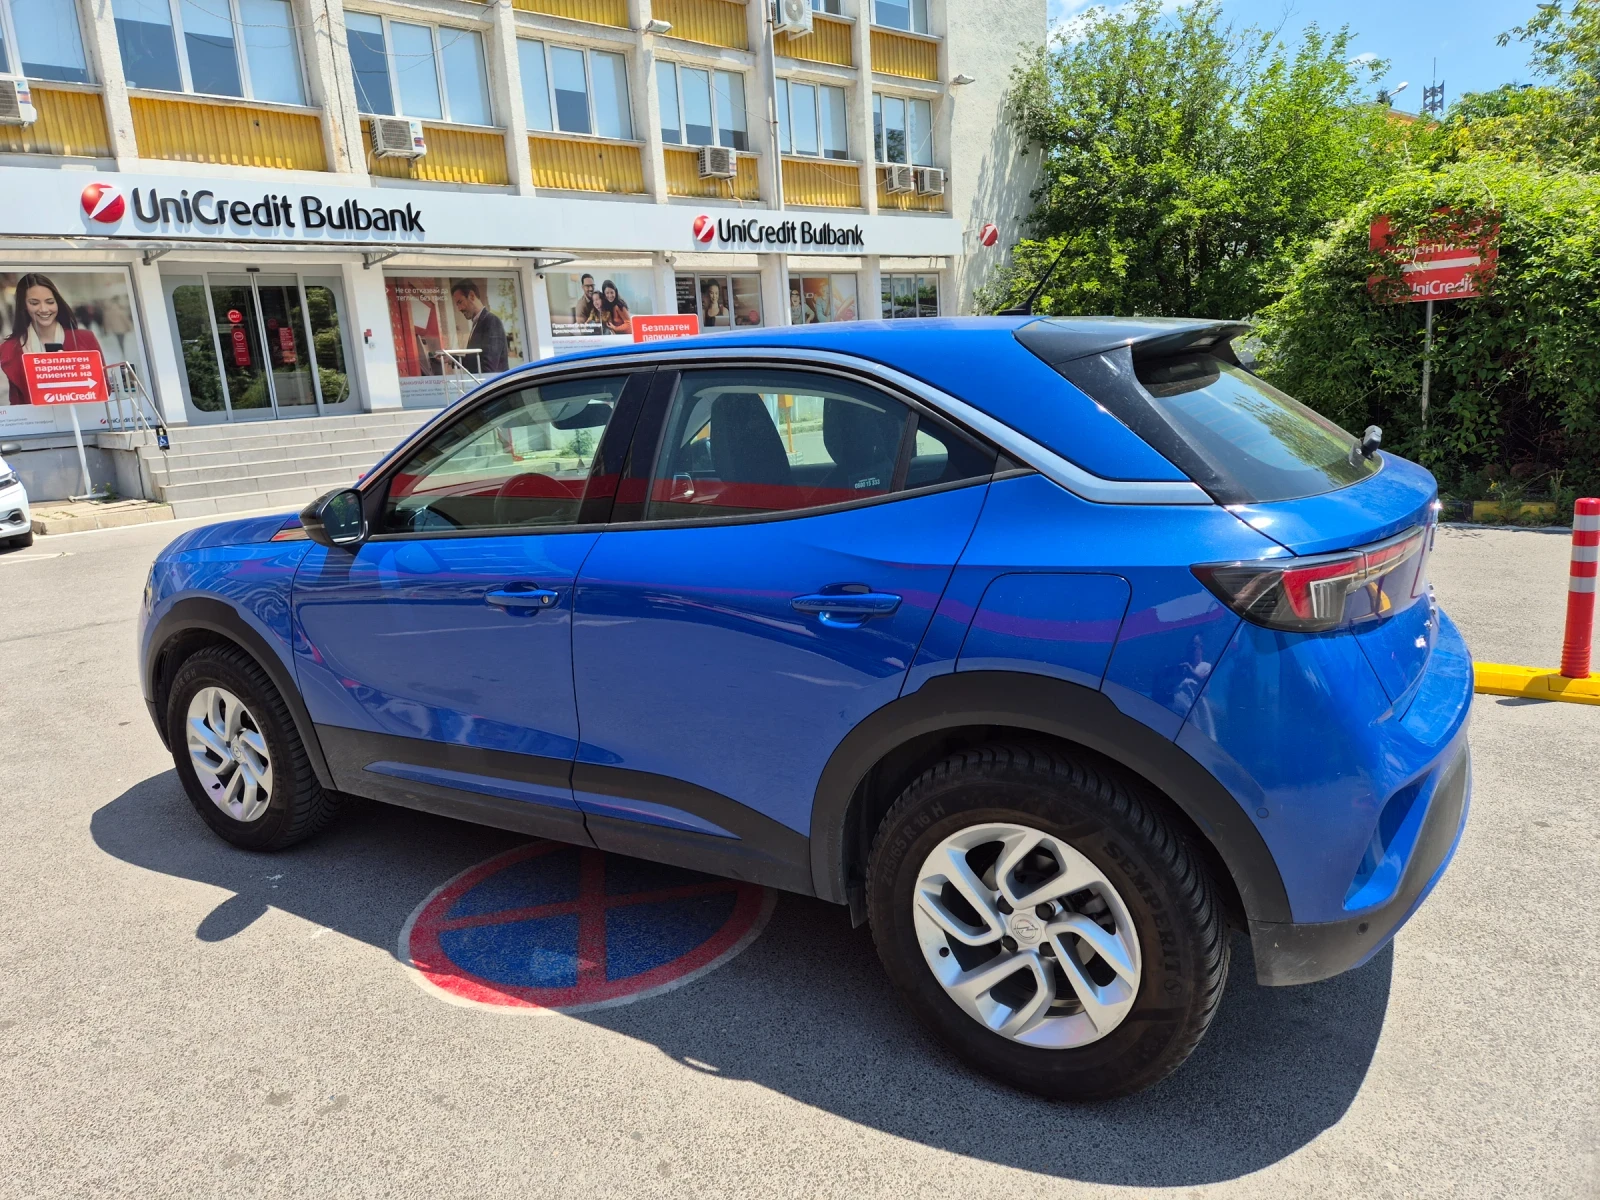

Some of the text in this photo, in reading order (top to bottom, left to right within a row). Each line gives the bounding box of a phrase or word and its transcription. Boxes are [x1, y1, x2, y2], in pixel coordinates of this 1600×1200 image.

[132, 187, 425, 233] UniCredit Bulbank
[718, 218, 864, 246] UniCredit Bulbank
[641, 323, 690, 332] Безплатен
[33, 356, 89, 365] Безплатен
[35, 364, 76, 373] паркинг
[36, 372, 77, 380] клиенти
[55, 391, 96, 402] UniCredit
[902, 825, 918, 840] R
[914, 811, 930, 829] 16
[930, 801, 946, 818] H
[1102, 839, 1185, 979] SEMPERIT
